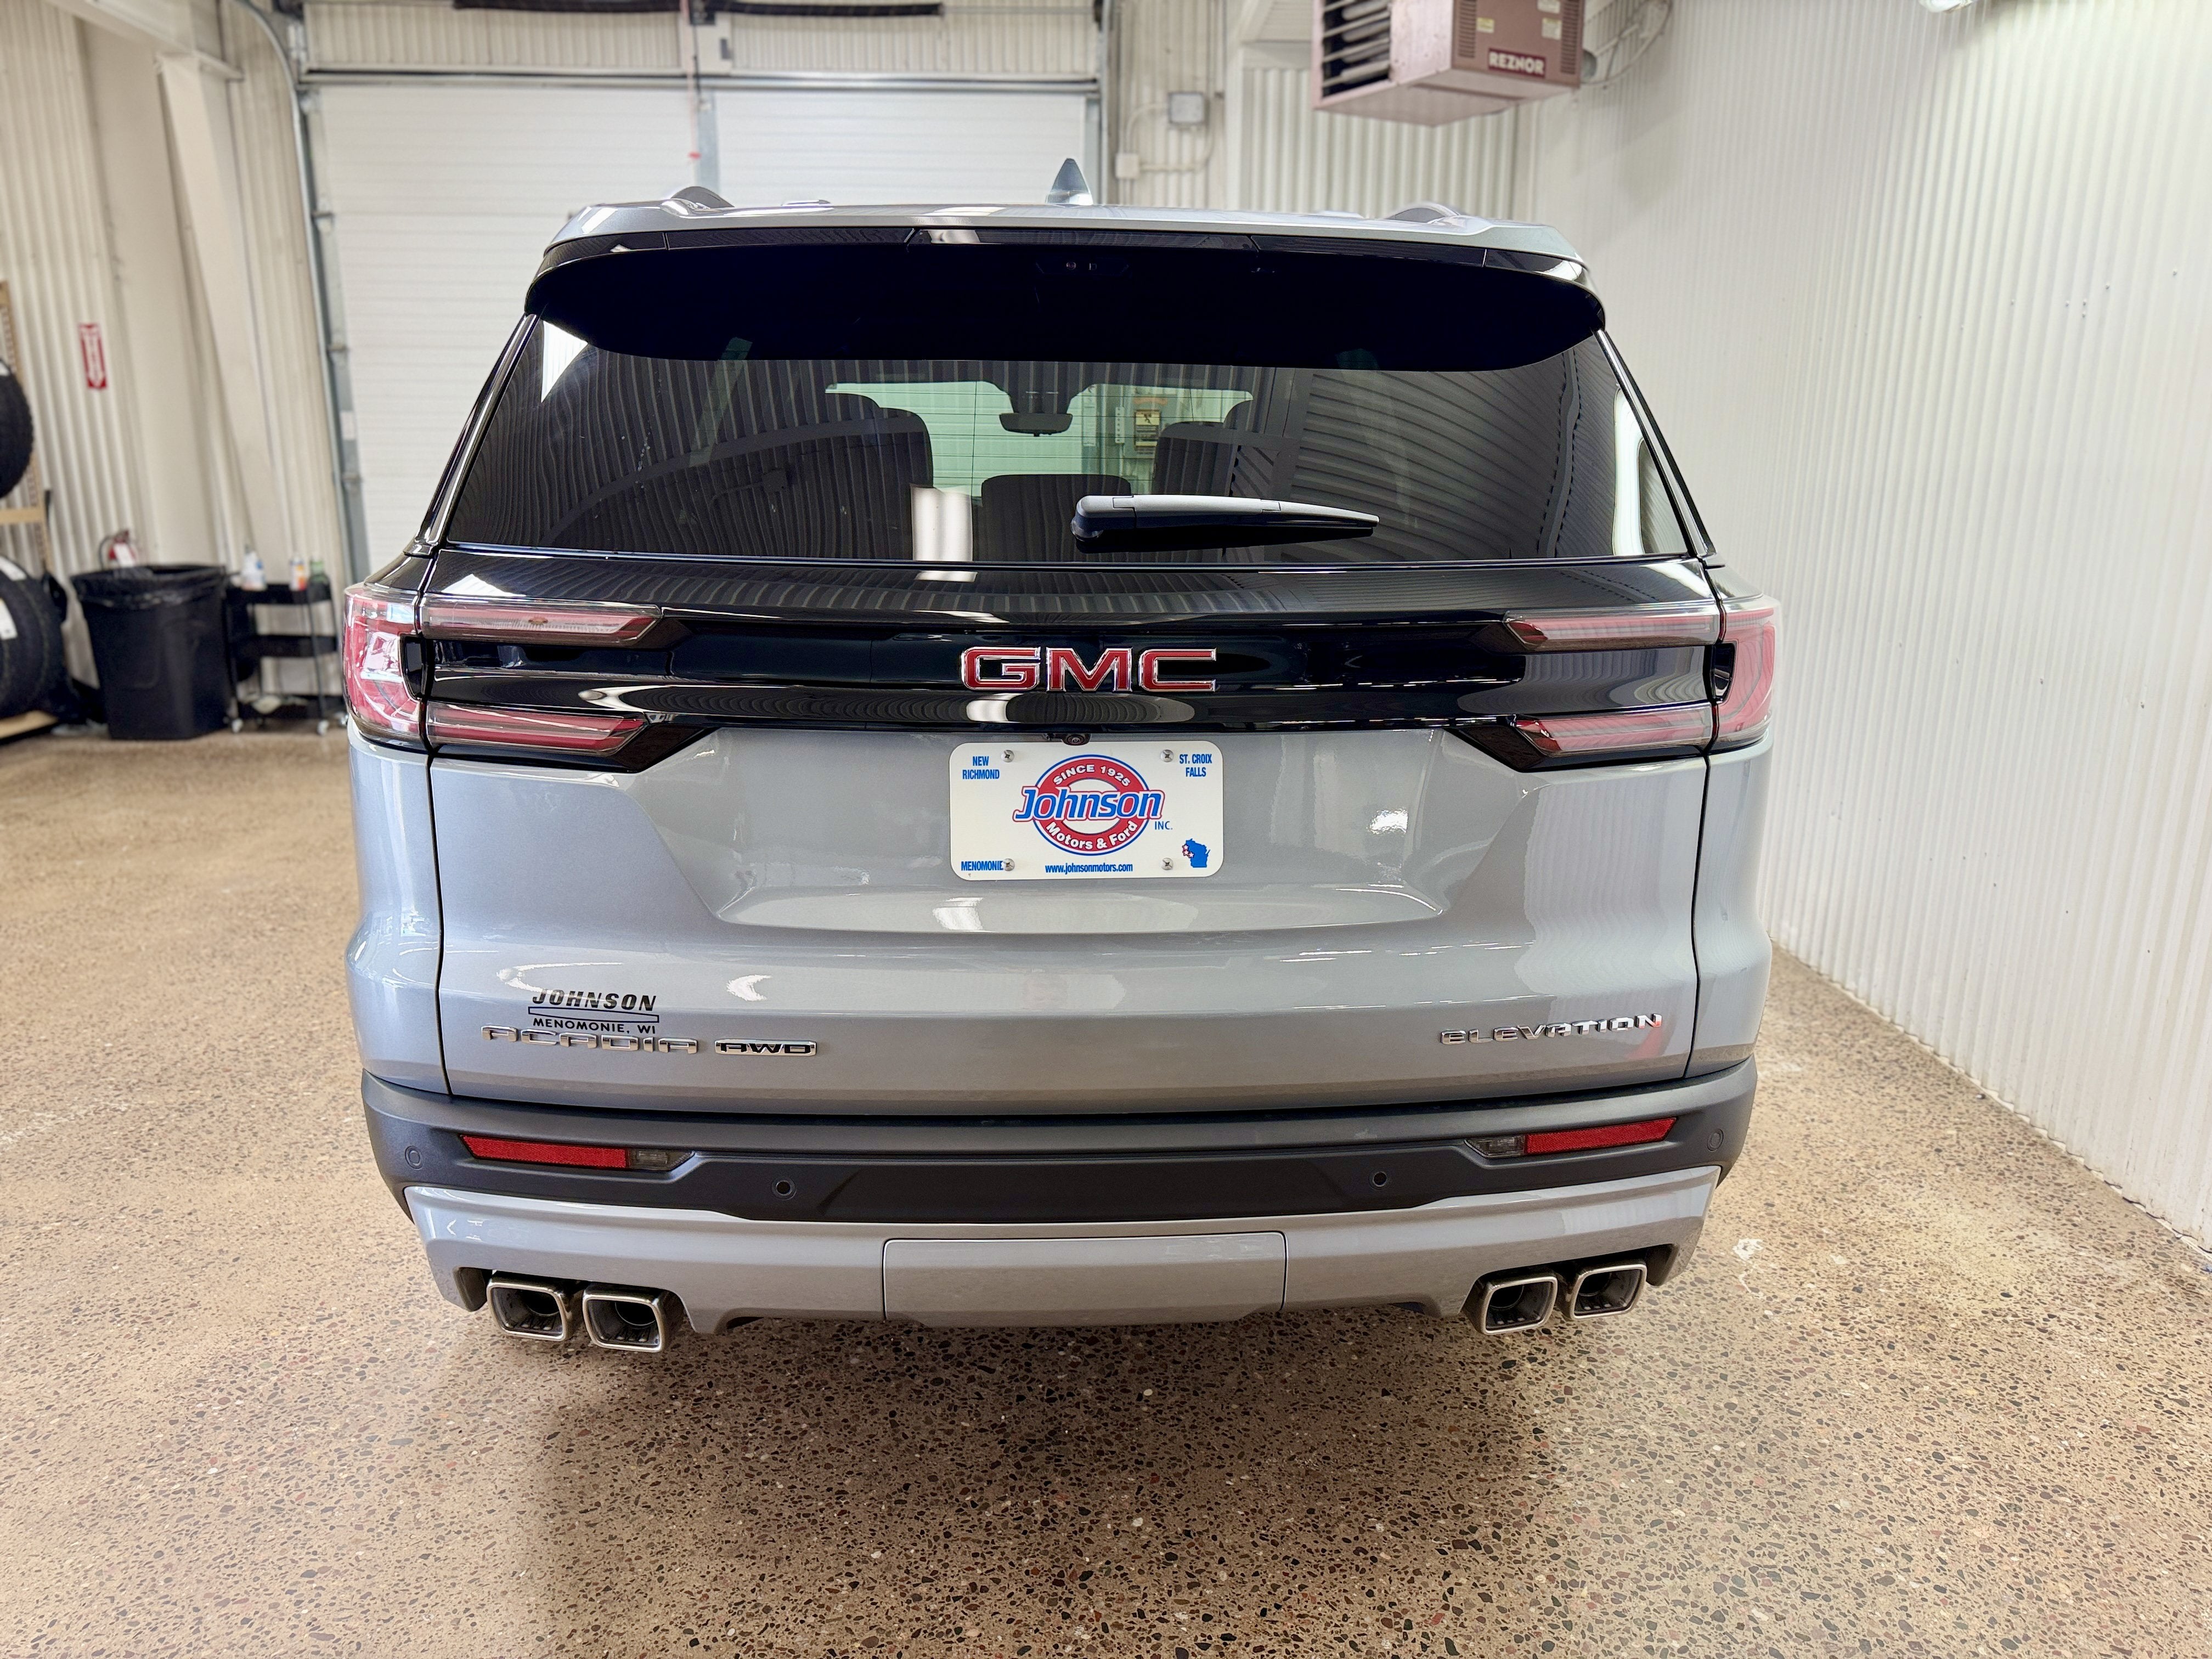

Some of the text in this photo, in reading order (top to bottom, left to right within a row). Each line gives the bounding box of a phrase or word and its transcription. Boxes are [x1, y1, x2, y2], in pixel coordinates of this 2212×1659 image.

[1489, 52, 1544, 75] REZNOR
[961, 646, 1216, 692] GMC
[973, 756, 989, 766] NEW
[1180, 753, 1212, 764] ST. CROIX
[962, 769, 1000, 780] RICHMOND
[1053, 764, 1131, 787] SINCE 1925
[1186, 767, 1206, 777] FALLS
[1014, 788, 1164, 821] Johnson
[1046, 820, 1138, 850] Motors & Ford
[1154, 821, 1173, 830] INC.
[961, 860, 1004, 871] MENOMONIE
[1045, 862, 1133, 874] www.johnsonmotors.com
[532, 989, 657, 1012] JOHNSON
[533, 1018, 656, 1034] MENOMONIE, WI
[1441, 1013, 1663, 1045] ELEVATION
[481, 1025, 813, 1055] ACADIA AWD
